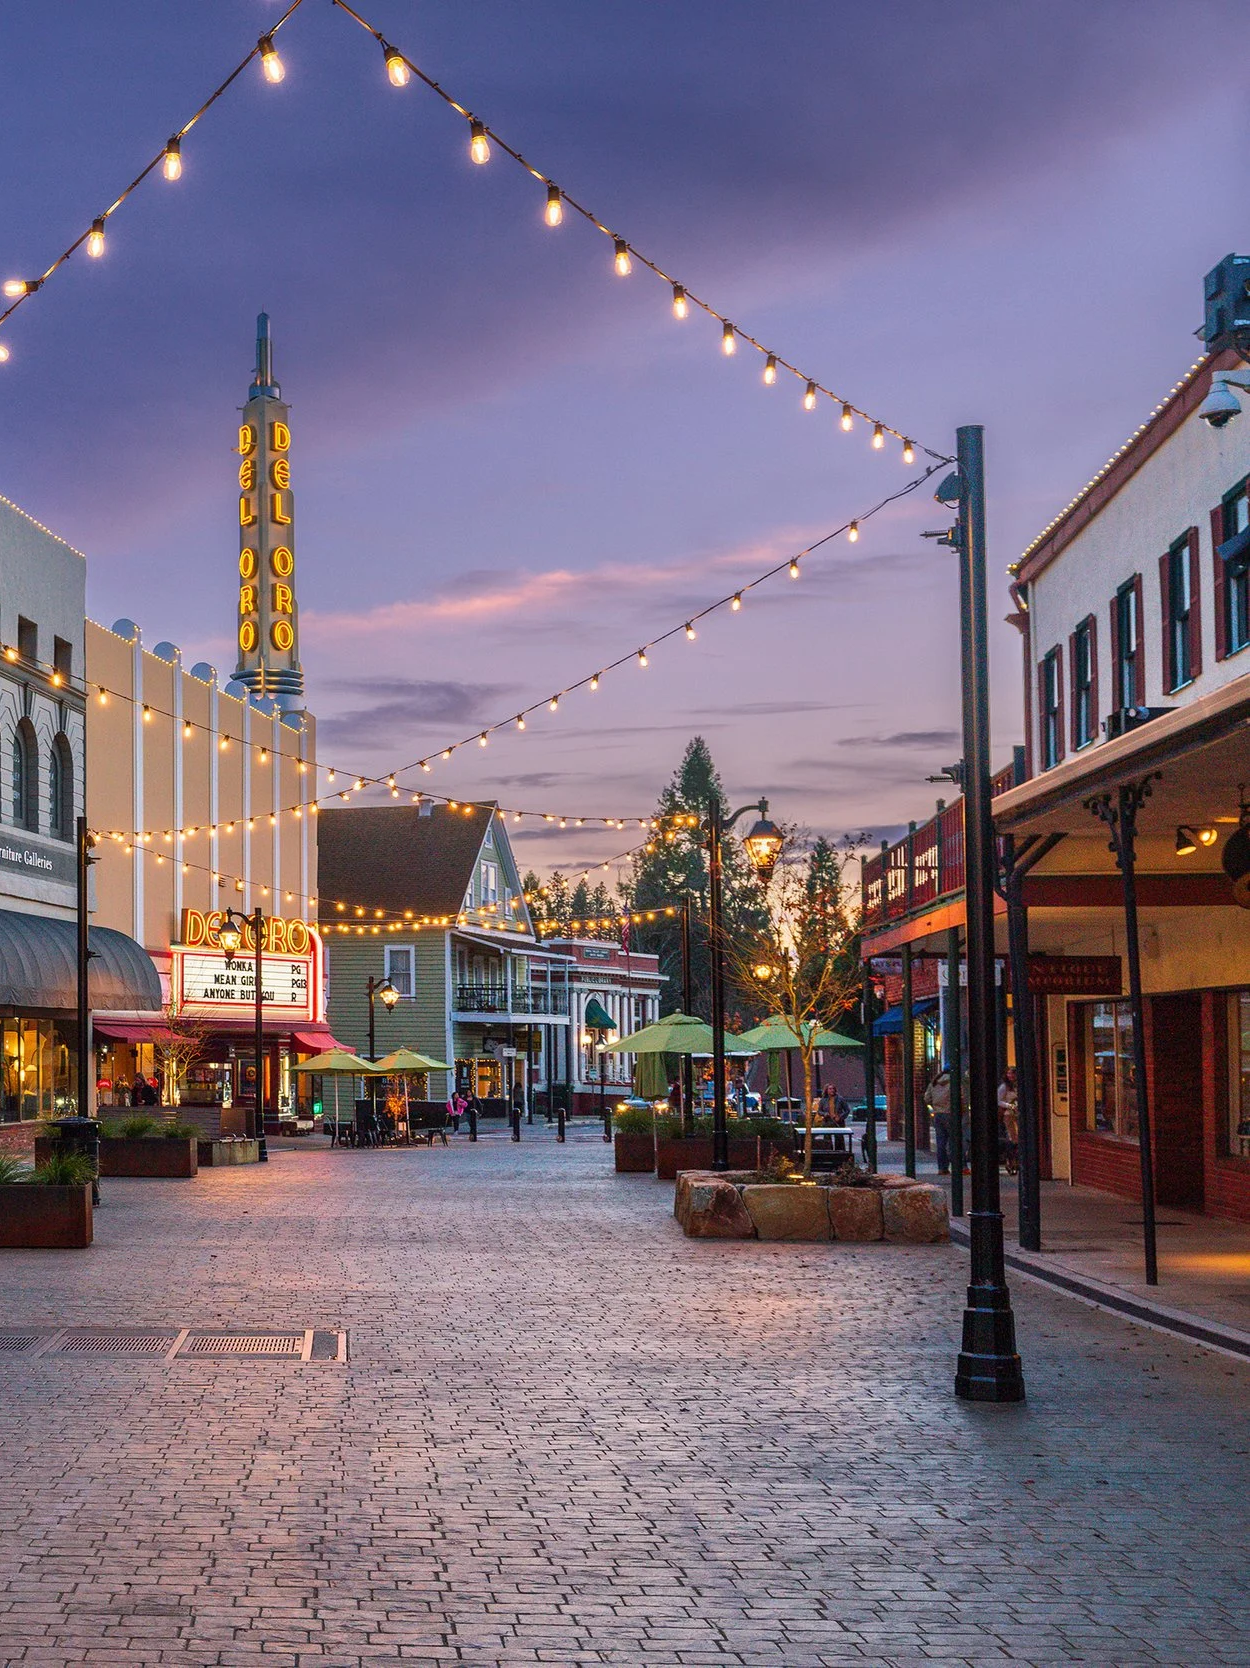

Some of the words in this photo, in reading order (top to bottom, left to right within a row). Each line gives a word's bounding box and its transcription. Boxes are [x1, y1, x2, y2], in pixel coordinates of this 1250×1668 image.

[238, 424, 257, 526] DEL
[271, 421, 292, 525] DEL
[238, 547, 258, 651] ORO
[271, 546, 294, 651] ORO
[23, 850, 53, 871] Galleries
[182, 909, 241, 950] DE
[244, 914, 309, 956] ORO
[214, 974, 237, 985] MEAN
[241, 976, 263, 987] GIR
[291, 979, 308, 989] PG13
[224, 960, 253, 972] WONKA
[291, 965, 301, 974] PG
[203, 988, 236, 999] ANYONE
[240, 990, 256, 1001] BUT
[291, 993, 297, 1002] R
